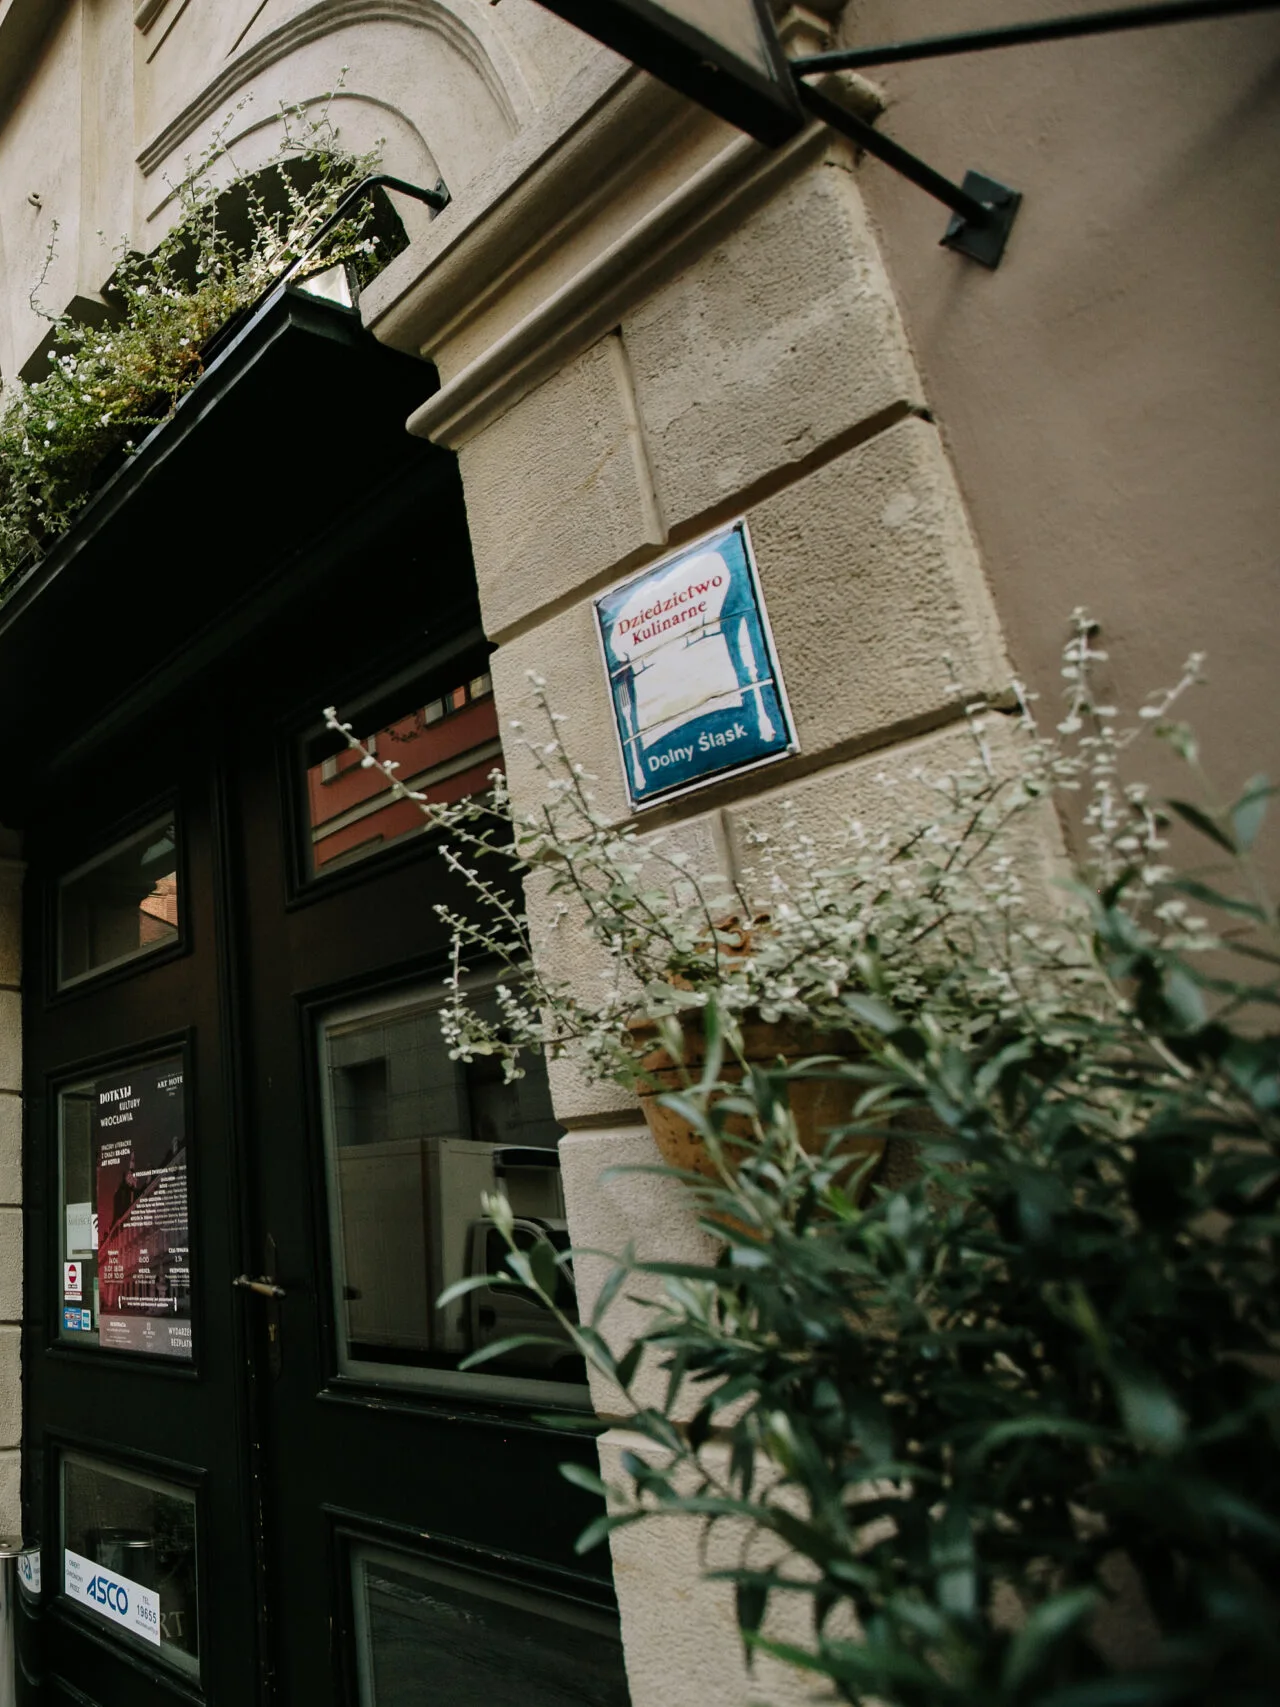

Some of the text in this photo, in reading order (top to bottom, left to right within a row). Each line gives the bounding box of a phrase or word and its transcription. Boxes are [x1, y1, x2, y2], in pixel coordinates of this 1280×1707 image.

[618, 574, 723, 636] Dziedzictwo
[632, 600, 707, 646] Kulinarne
[648, 723, 748, 772] Dolny Śląsk
[157, 1075, 183, 1088] ART HOTE
[100, 1112, 133, 1127] WROCŁAWIA
[119, 1098, 140, 1111] KULTURY
[86, 1574, 129, 1616] ASCO
[136, 1603, 157, 1625] 19655
